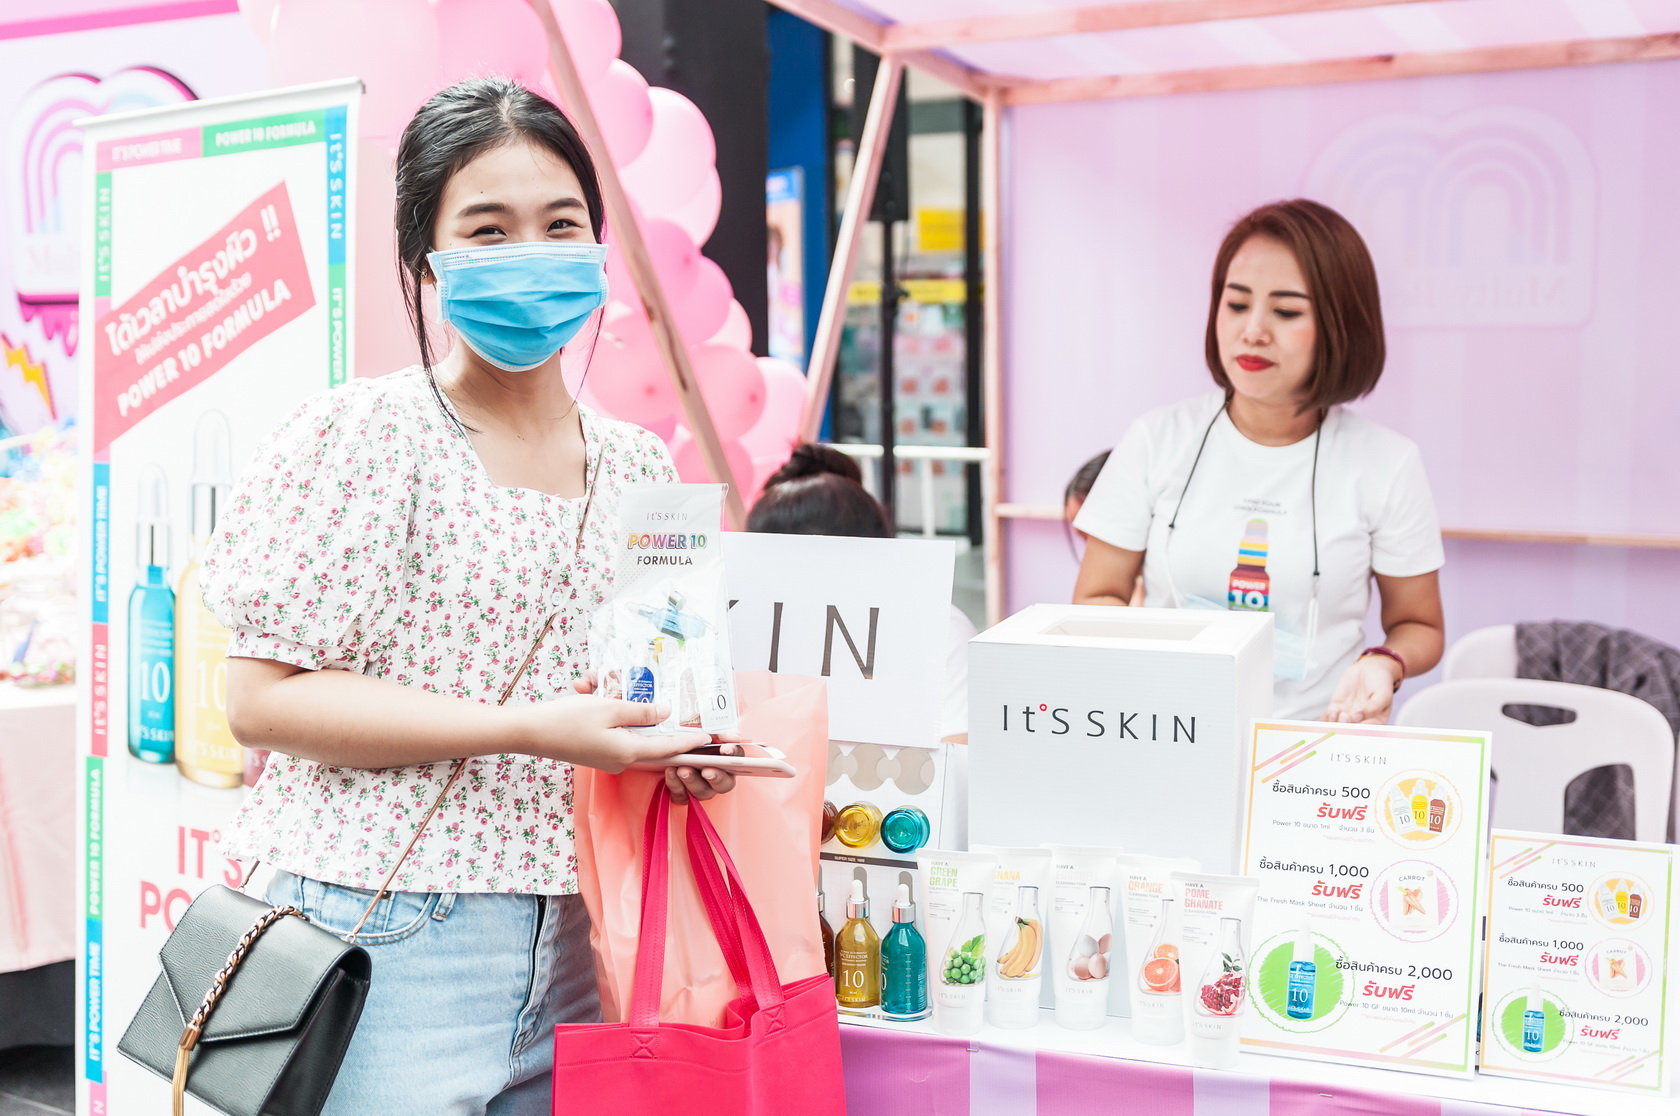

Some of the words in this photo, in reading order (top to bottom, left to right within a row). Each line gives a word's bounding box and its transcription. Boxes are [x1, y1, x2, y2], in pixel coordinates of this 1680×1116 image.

[215, 129, 251, 148] POWER
[252, 126, 265, 143] 10
[266, 120, 316, 140] FORMULA
[98, 187, 110, 241] SKIN
[330, 177, 344, 240] SKIN
[116, 357, 180, 418] POWER
[177, 343, 202, 373] 10
[201, 278, 292, 357] FORMULA
[332, 321, 344, 379] POWER
[664, 511, 688, 522] SKIN
[627, 533, 687, 550] POWER
[690, 534, 708, 550] 10
[636, 555, 693, 566] FORMULA
[1232, 579, 1266, 591] POWER
[1232, 590, 1266, 609] 10
[729, 599, 880, 680] IN
[95, 643, 107, 697] SKIN
[140, 661, 171, 703] 10
[1086, 710, 1196, 744] SKIN
[1354, 754, 1387, 766] SKIN
[1272, 779, 1337, 799] ซื้อสินค้าครบ
[1341, 786, 1371, 800] 500
[89, 768, 101, 840] FORMULA
[1316, 801, 1368, 822] รับฟรี
[1400, 814, 1410, 825] 10
[1414, 810, 1426, 820] 10
[1430, 814, 1441, 825] 10
[1272, 820, 1293, 828] Power
[90, 842, 101, 858] 10
[1259, 856, 1324, 876] ซื้อสินค้าครบ
[1328, 863, 1369, 879] 1,000
[1570, 859, 1597, 868] SKIN
[930, 866, 958, 878] GREEN
[1398, 874, 1426, 883] CARROT
[89, 861, 102, 916] POWER
[929, 876, 958, 888] GRAPE
[1128, 881, 1163, 894] ORANGE
[1507, 876, 1558, 892] ซื้อสินค้าครบ
[1561, 882, 1584, 894] 500
[1185, 888, 1210, 899] POME
[1311, 880, 1362, 901] รับฟรี
[1184, 898, 1224, 911] GRANATE
[1270, 896, 1288, 905] Fresh
[1542, 894, 1582, 910] รับฟรี
[1606, 904, 1616, 912] 10
[1617, 902, 1626, 910] 10
[1629, 905, 1638, 914] 10
[1499, 934, 1549, 948] ซื้อสินค้าครบ
[1552, 940, 1584, 952] 1,000
[90, 942, 102, 976] TIME
[1540, 951, 1579, 967] รับฟรี
[1335, 956, 1403, 977] ซื้อสินค้าครบ
[1407, 964, 1453, 982] 2,000
[843, 970, 865, 988] 10
[1292, 988, 1308, 1002] 10
[1362, 981, 1415, 1002] รับฟรี
[90, 978, 102, 1032] POWER
[1339, 999, 1359, 1008] Power
[1614, 1014, 1649, 1028] 2,000
[1525, 1028, 1539, 1041] 10
[1580, 1025, 1620, 1041] รับฟรี
